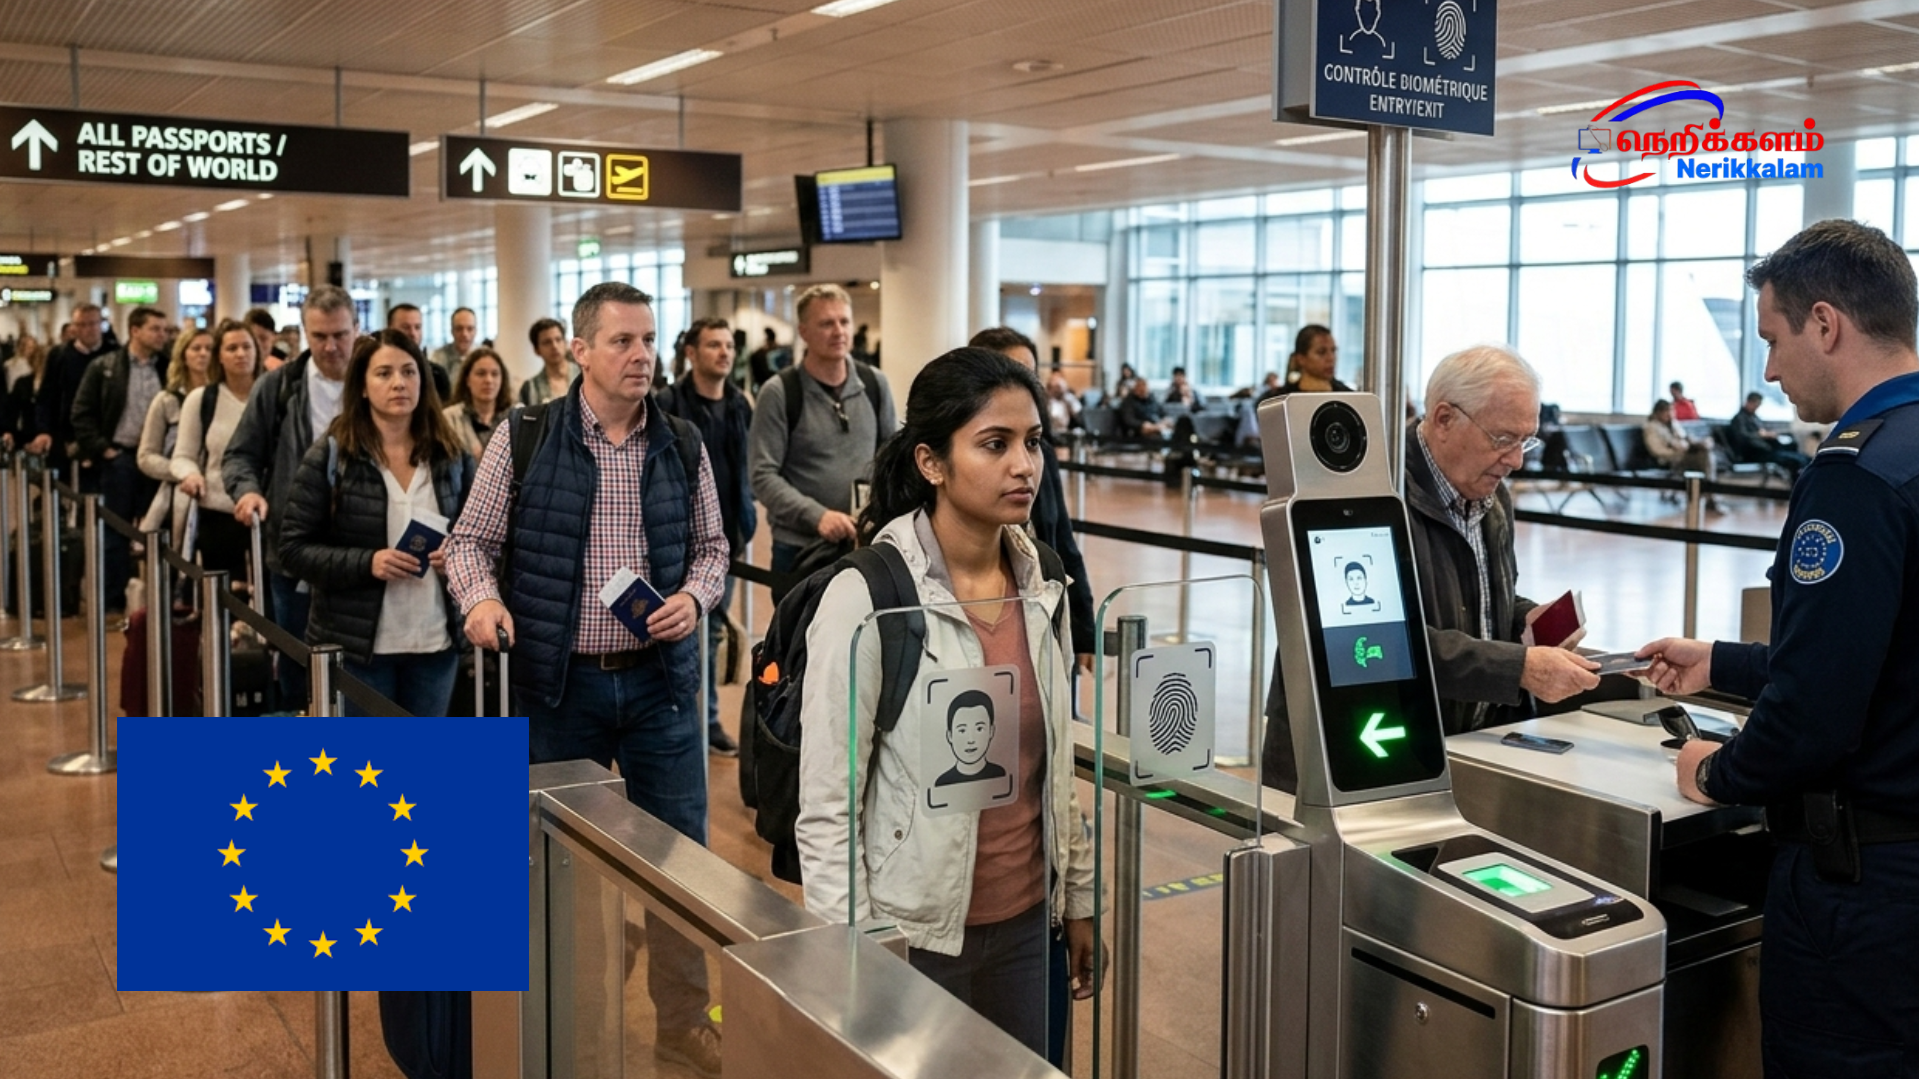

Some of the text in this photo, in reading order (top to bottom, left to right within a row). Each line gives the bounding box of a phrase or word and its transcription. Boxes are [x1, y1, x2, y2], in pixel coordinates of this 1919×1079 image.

[1401, 74, 1488, 102] BIOMÉTRIQUE
[77, 122, 287, 156] ALL PASSPORTS /
[78, 150, 278, 182] REST OF WORLD
